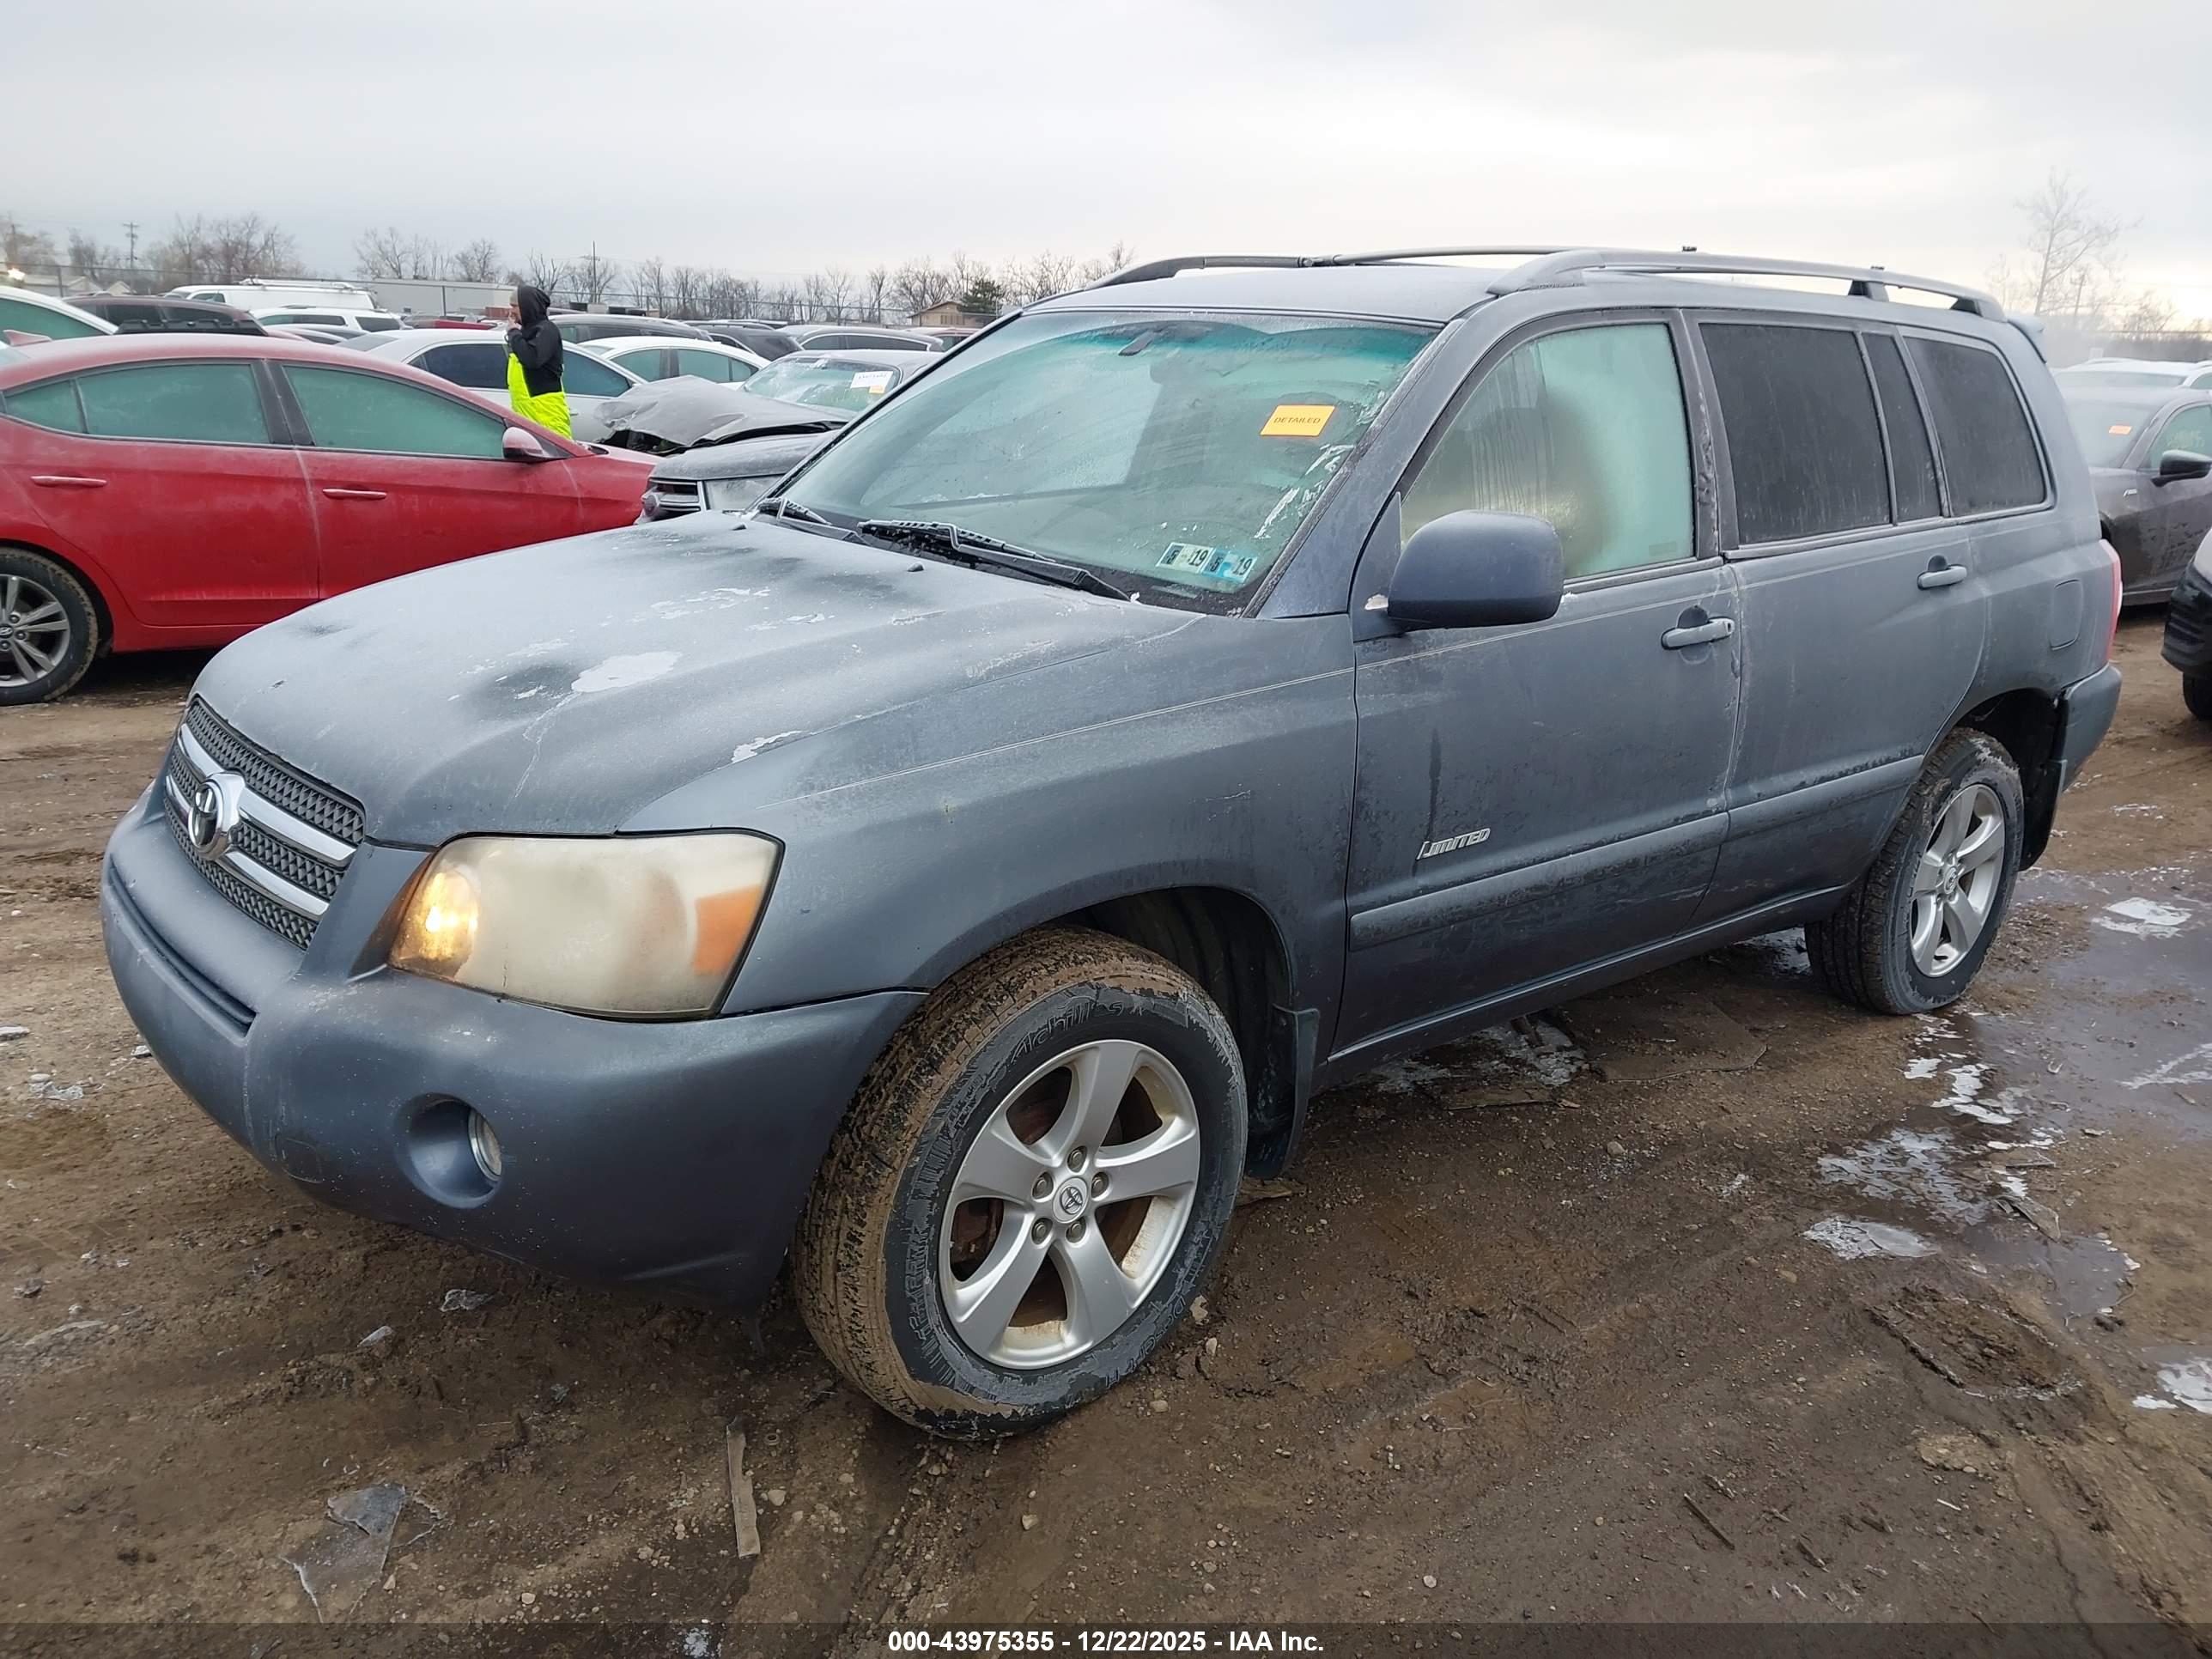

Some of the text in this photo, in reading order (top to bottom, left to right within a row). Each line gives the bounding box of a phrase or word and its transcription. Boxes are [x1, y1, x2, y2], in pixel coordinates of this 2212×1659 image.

[1233, 557, 1253, 576] 19
[1415, 827, 1492, 861] LIMITED
[1011, 1001, 1125, 1065] Achills
